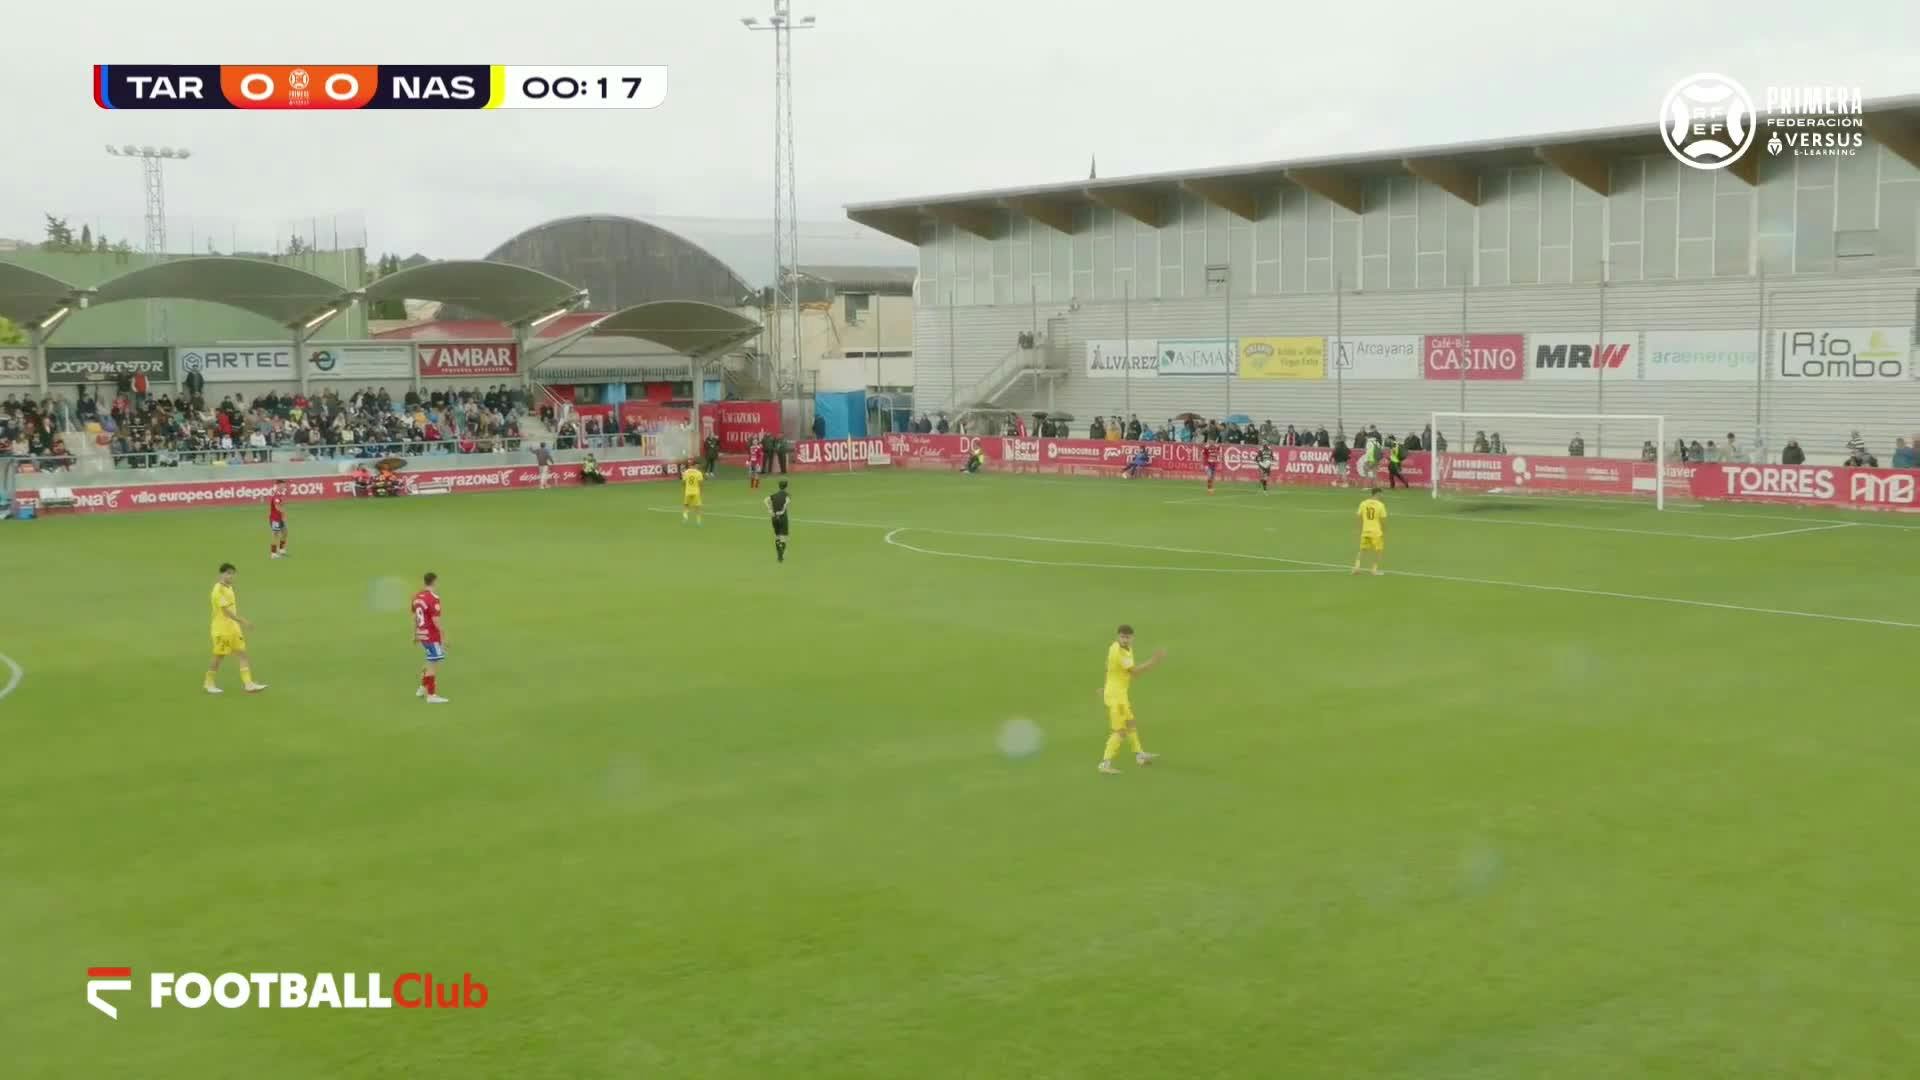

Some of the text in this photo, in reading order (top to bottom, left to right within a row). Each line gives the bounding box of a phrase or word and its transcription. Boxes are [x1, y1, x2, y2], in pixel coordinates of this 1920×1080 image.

[0, 356, 30, 371] ES
[204, 352, 289, 368] ARTEC
[437, 349, 512, 367] AMBAR
[1430, 349, 1516, 370] CASINO
[1536, 344, 1631, 368] MRW
[1782, 332, 1902, 377] Lombo
[806, 443, 822, 463] LA
[824, 440, 884, 462] SOCEDAD
[1300, 451, 1334, 462] GRUA
[1286, 463, 1314, 473] AUTO
[158, 489, 211, 505] europea
[290, 481, 324, 495] 2024
[1721, 467, 1835, 499] TORRES
